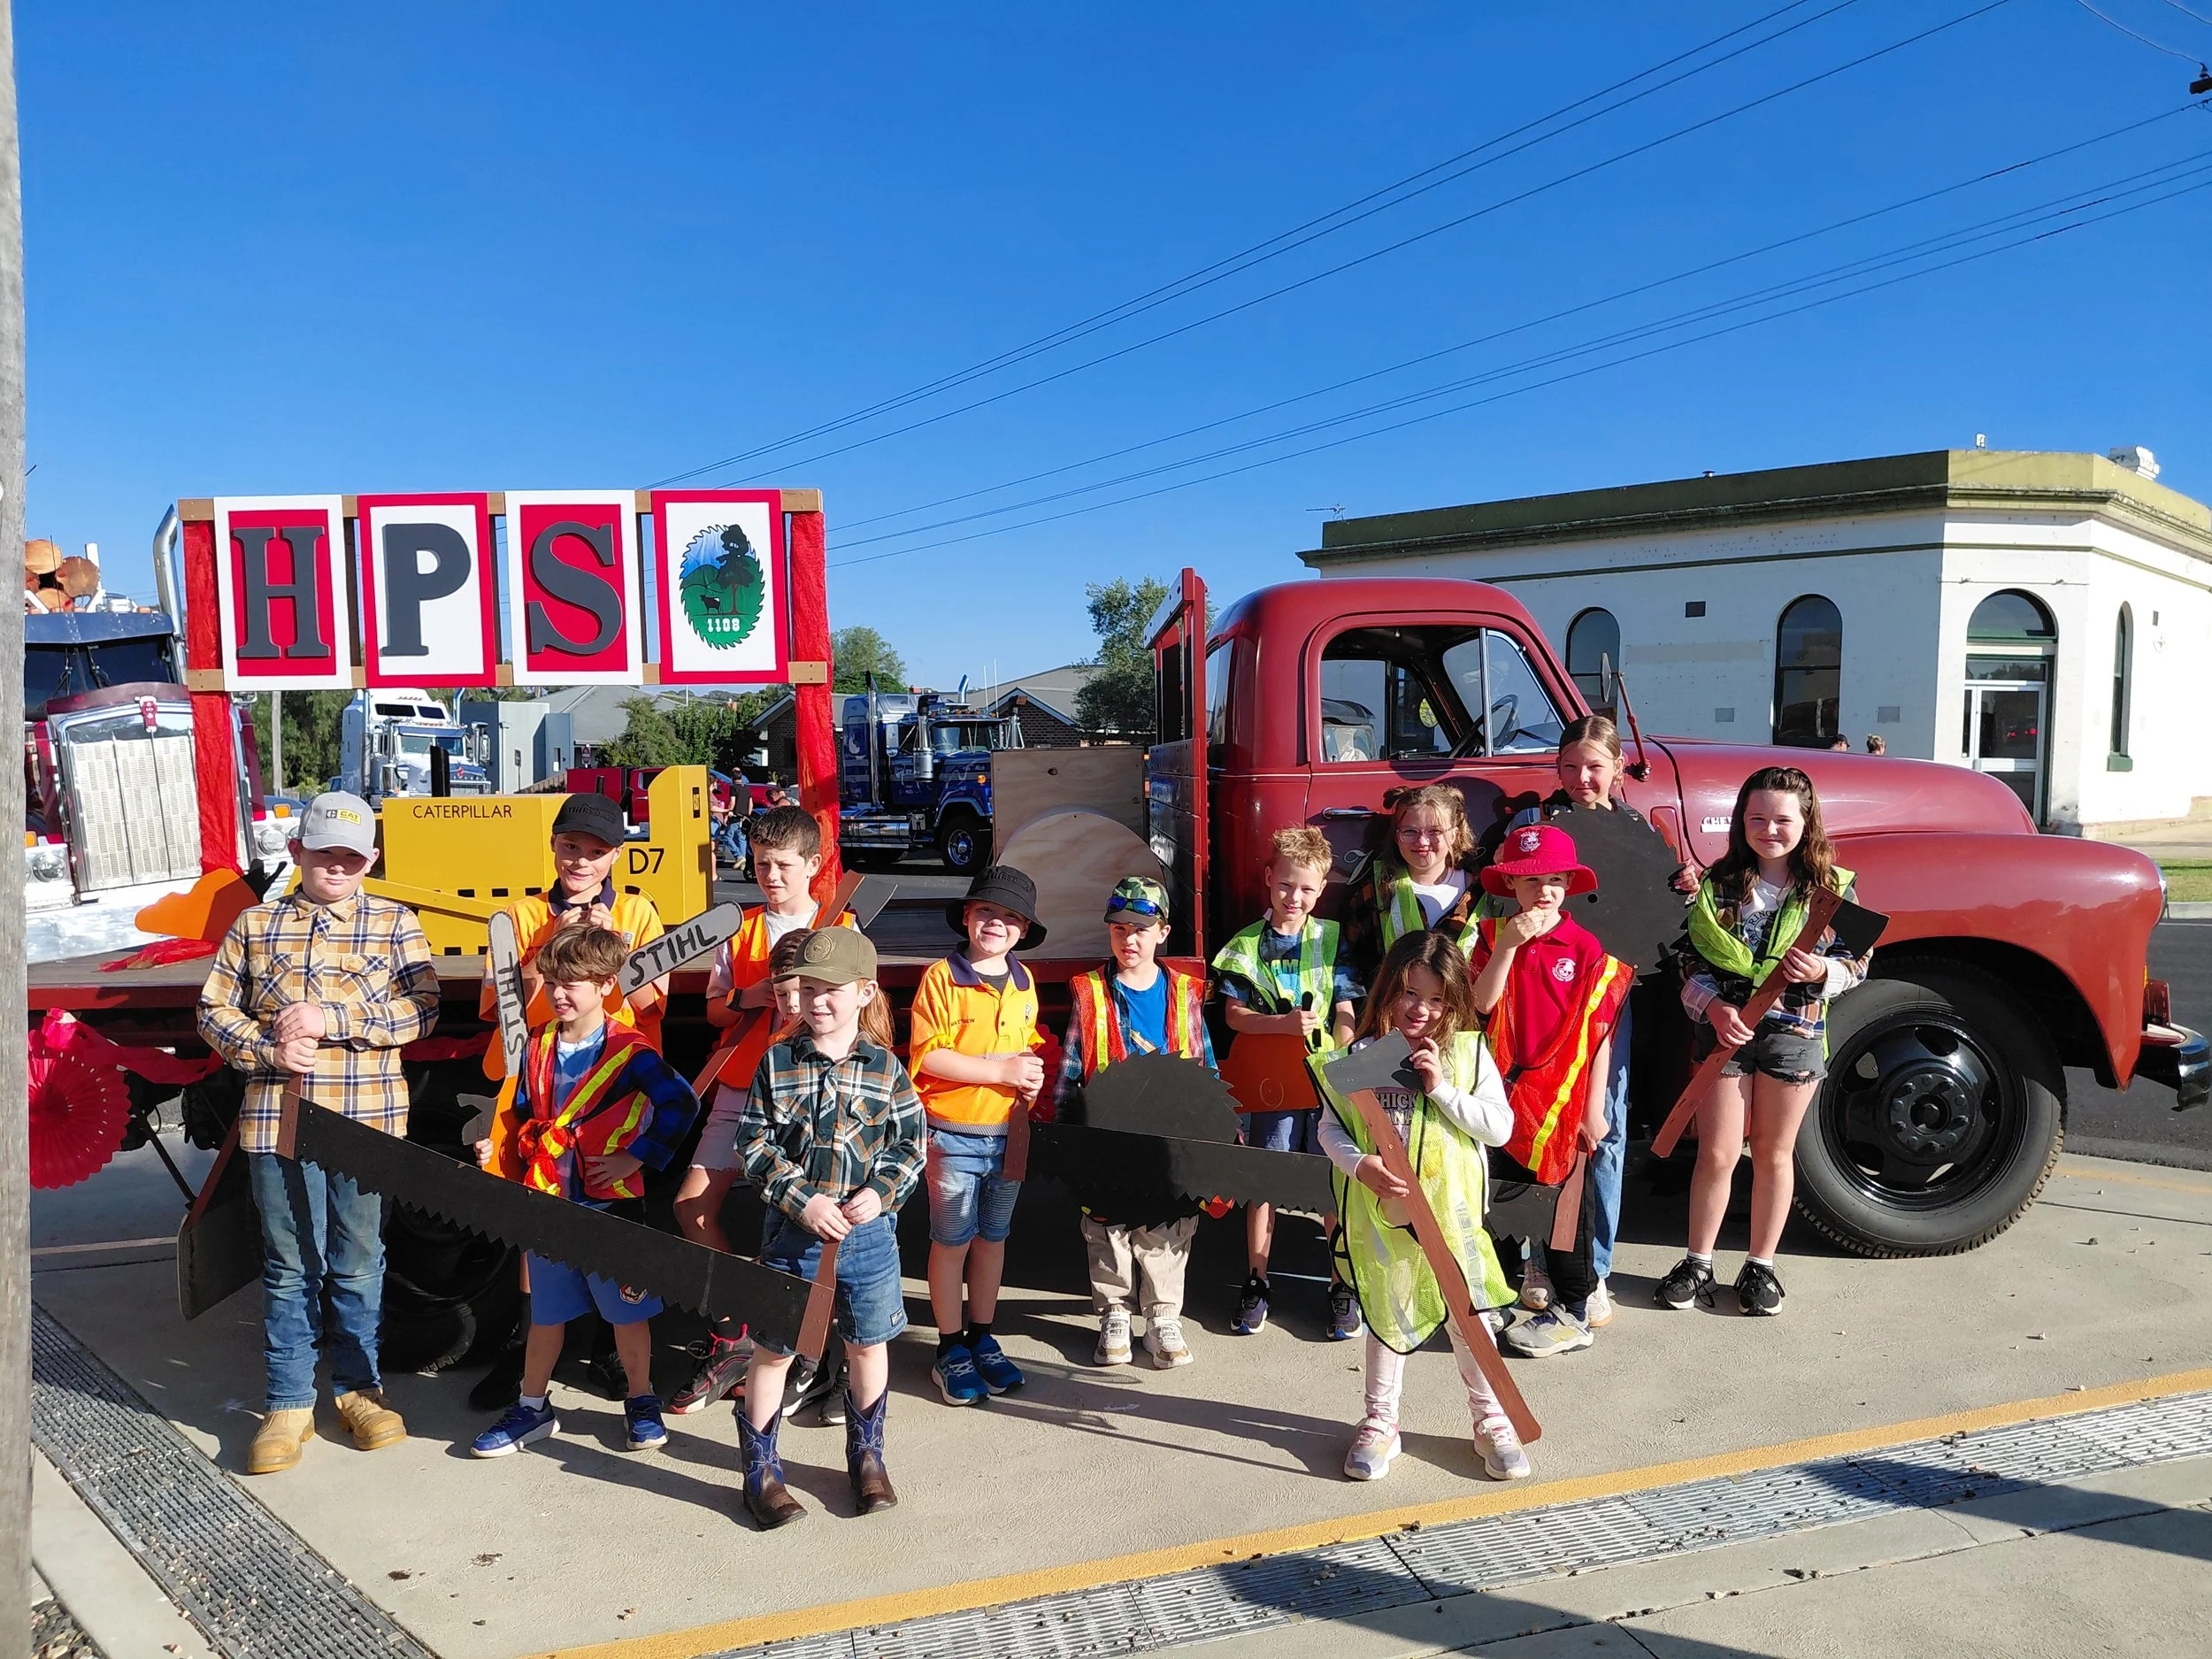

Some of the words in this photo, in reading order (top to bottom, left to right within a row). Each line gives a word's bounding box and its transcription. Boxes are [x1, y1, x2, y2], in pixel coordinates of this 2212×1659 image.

[708, 618, 740, 632] 1108
[340, 810, 359, 820] CAT
[412, 804, 512, 818] CATERPILLAR
[629, 848, 664, 874] D7
[629, 924, 718, 987] STIHL
[497, 950, 526, 1056] STIHL
[950, 1018, 975, 1026] MATTHEW
